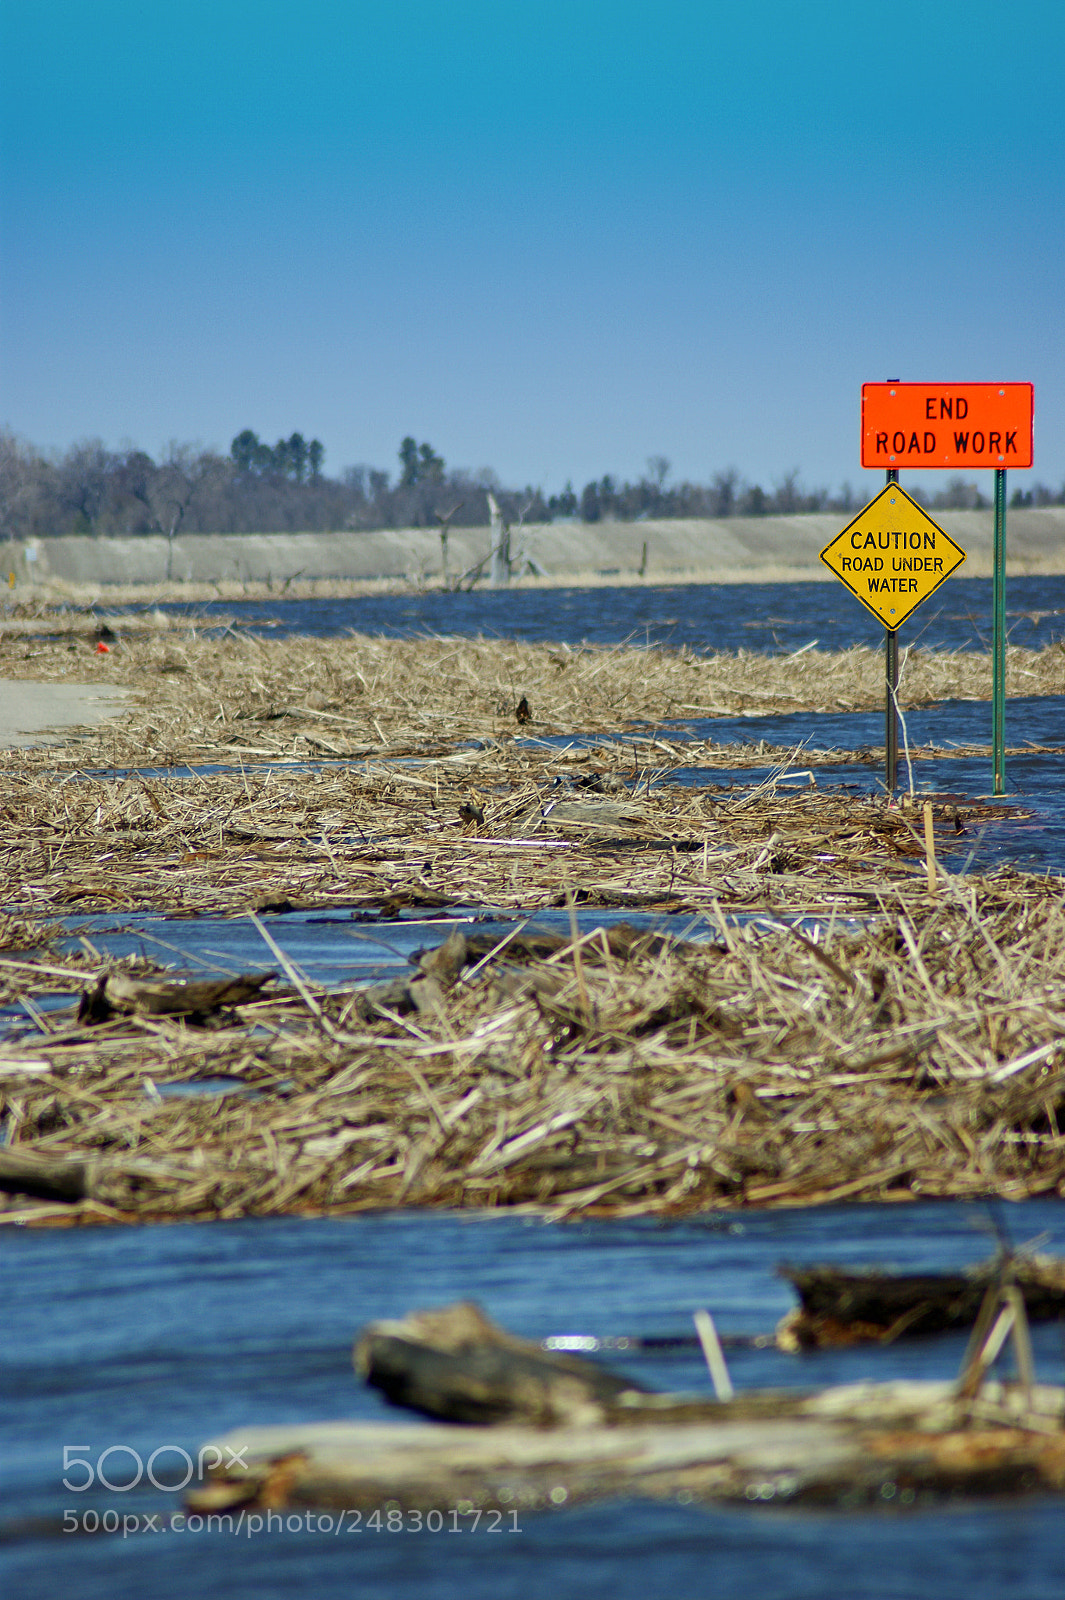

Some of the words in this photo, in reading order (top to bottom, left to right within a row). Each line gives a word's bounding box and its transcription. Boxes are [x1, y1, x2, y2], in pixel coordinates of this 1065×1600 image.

[925, 398, 969, 420] END
[876, 432, 937, 454] ROAD
[953, 432, 1018, 454] WORK
[850, 532, 936, 550] CAUTION
[842, 557, 884, 572] ROAD
[892, 557, 944, 572] UNDER
[867, 578, 918, 593] WATER
